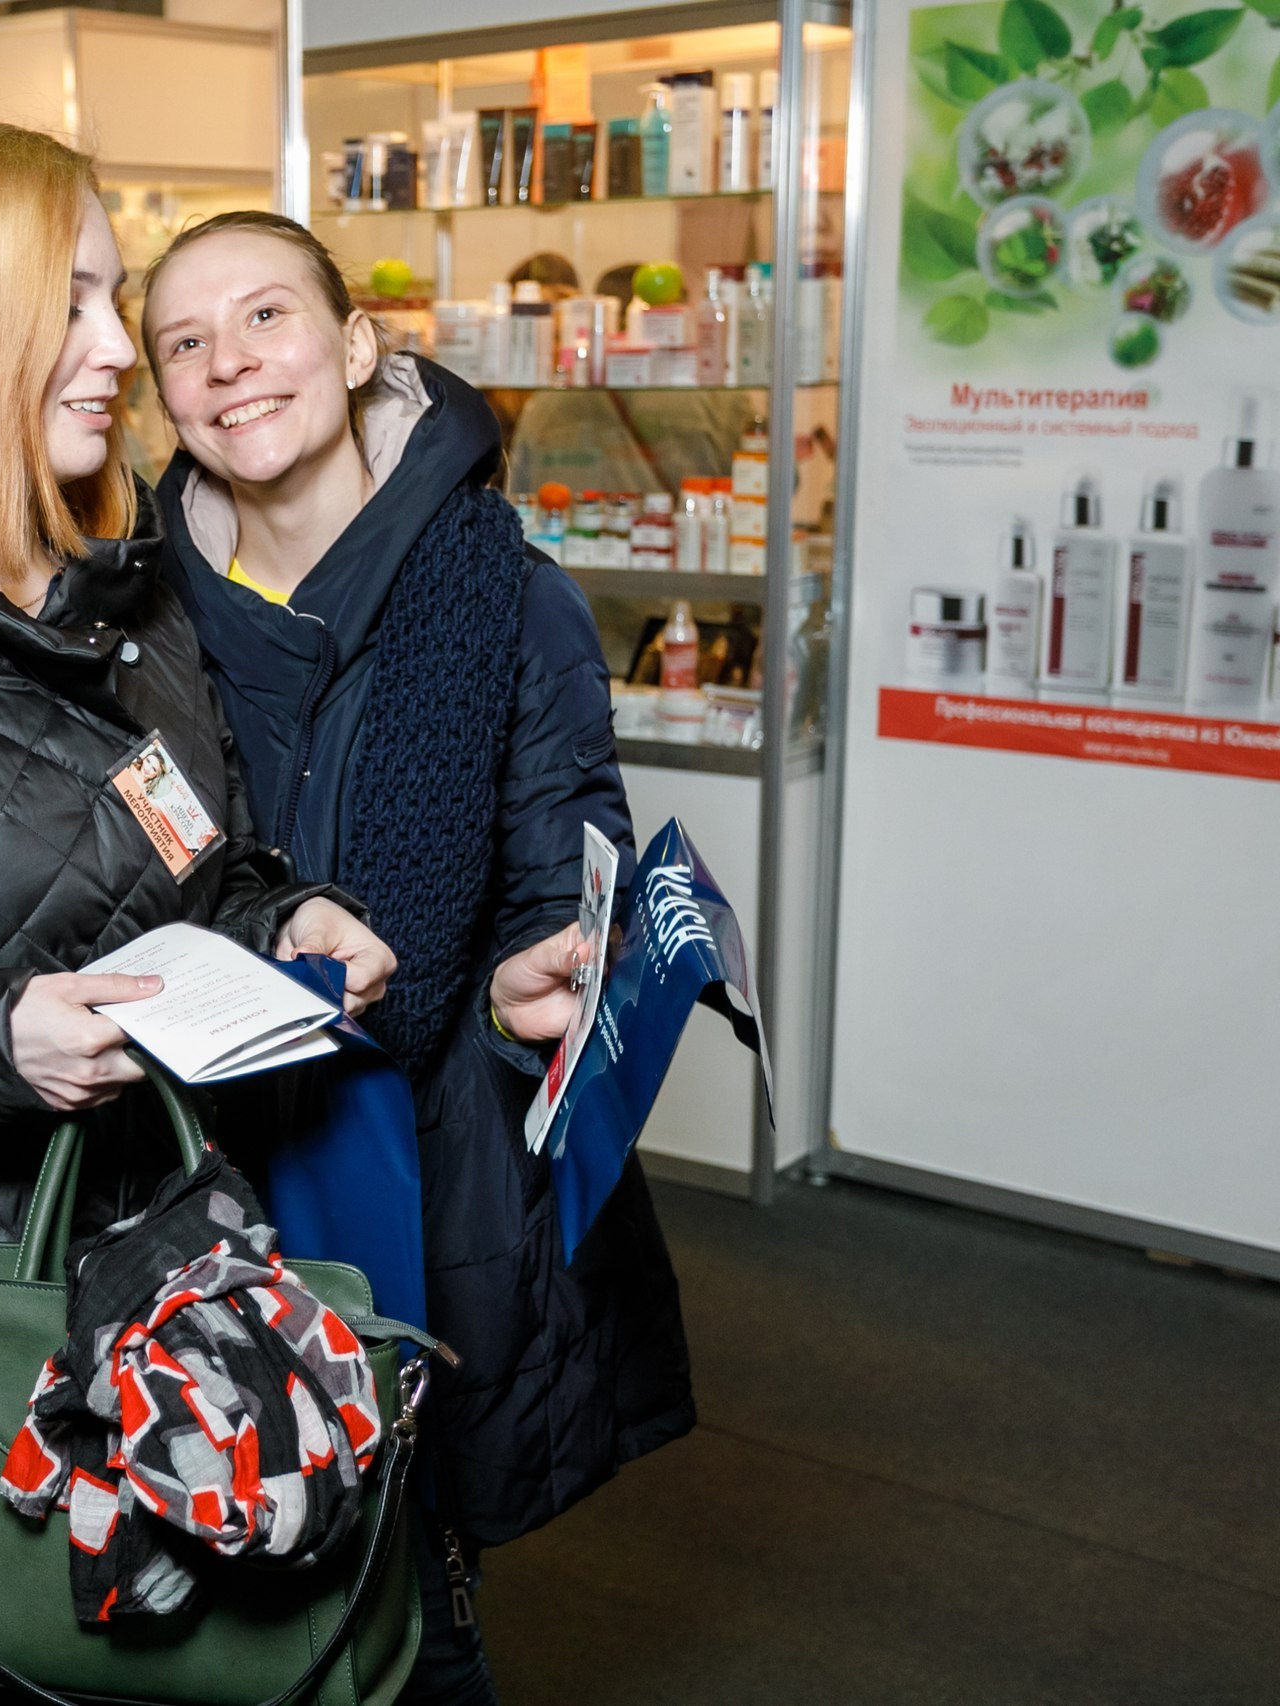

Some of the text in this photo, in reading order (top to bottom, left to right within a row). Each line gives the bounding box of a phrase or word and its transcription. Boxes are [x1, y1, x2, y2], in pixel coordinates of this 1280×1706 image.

[950, 382, 1150, 413] Мультитерапия
[123, 788, 176, 862] МЕРОПРИЯТИЯ
[136, 792, 175, 846] УЧАСТНИК
[208, 1008, 269, 1036] КОНТАКТЫ
